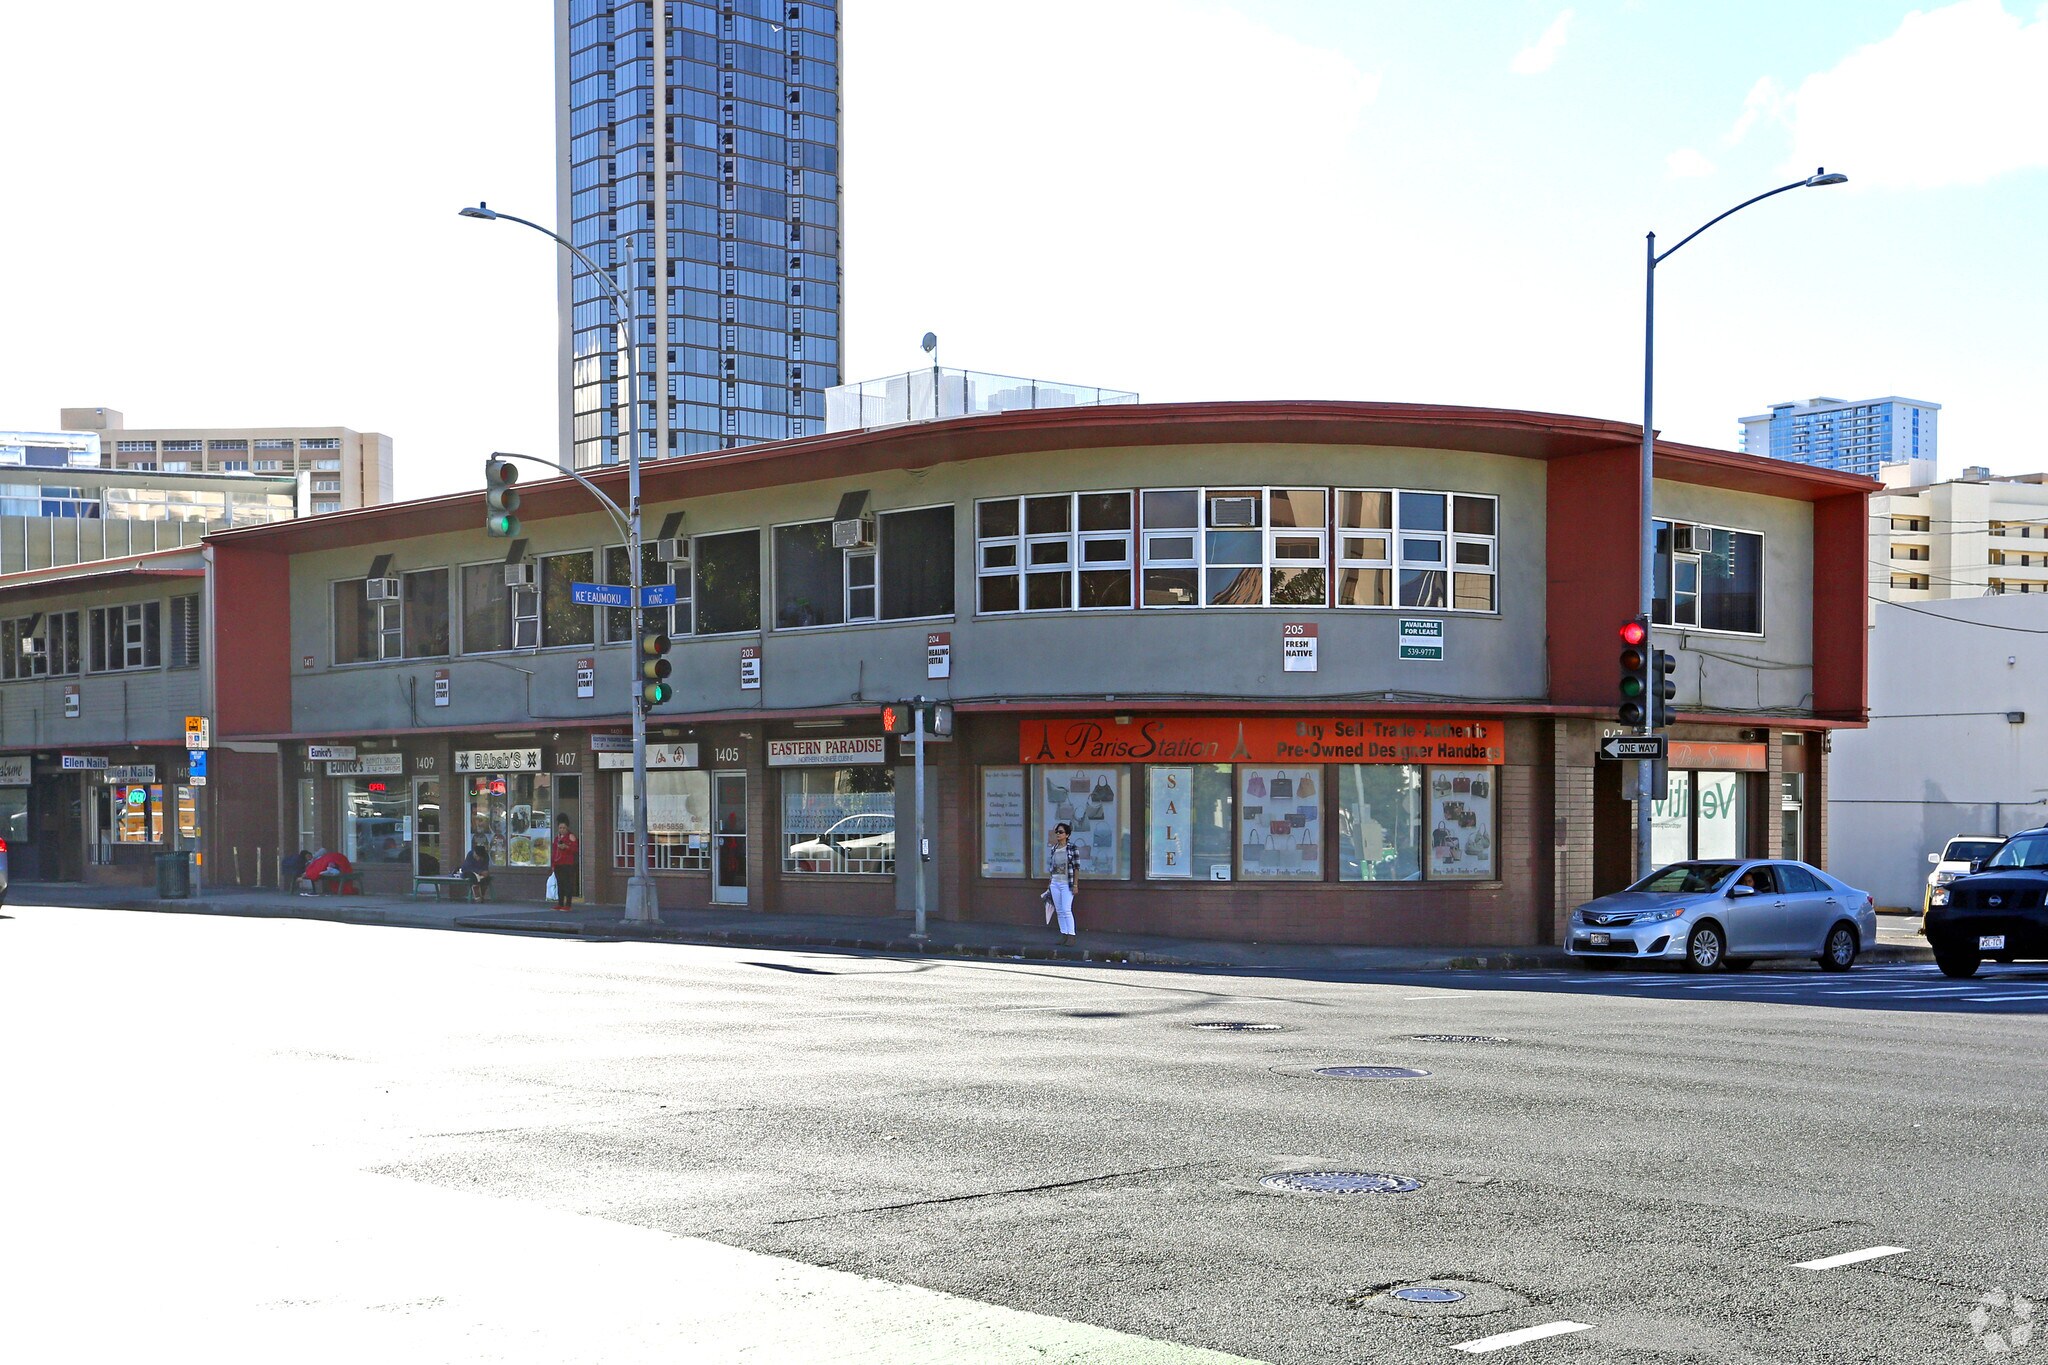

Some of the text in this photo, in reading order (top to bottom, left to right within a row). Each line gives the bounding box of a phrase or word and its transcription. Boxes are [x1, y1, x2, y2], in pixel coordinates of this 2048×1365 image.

[648, 595, 662, 604] KING
[1285, 625, 1303, 634] 205
[742, 649, 754, 657] 203
[929, 648, 949, 656] HEALING
[1408, 648, 1435, 656] 539-9777
[1296, 721, 1487, 739] Buy Sell Trade Authentic
[1064, 721, 1219, 759] Paris Station
[311, 748, 332, 757] Eunice's
[771, 739, 883, 756] EASTERN PARADISE
[1277, 742, 1500, 762] Pre-Owned Designer Handbags
[1619, 744, 1655, 752] ONE WAY
[555, 752, 576, 766] 1407
[715, 748, 739, 762] 1405
[64, 757, 107, 768] Ellen Nails
[330, 760, 364, 773] Eunice's
[415, 757, 435, 770] 1409
[130, 766, 154, 778] Nails
[369, 783, 386, 792] OPEN
[1165, 773, 1178, 866] SALE
